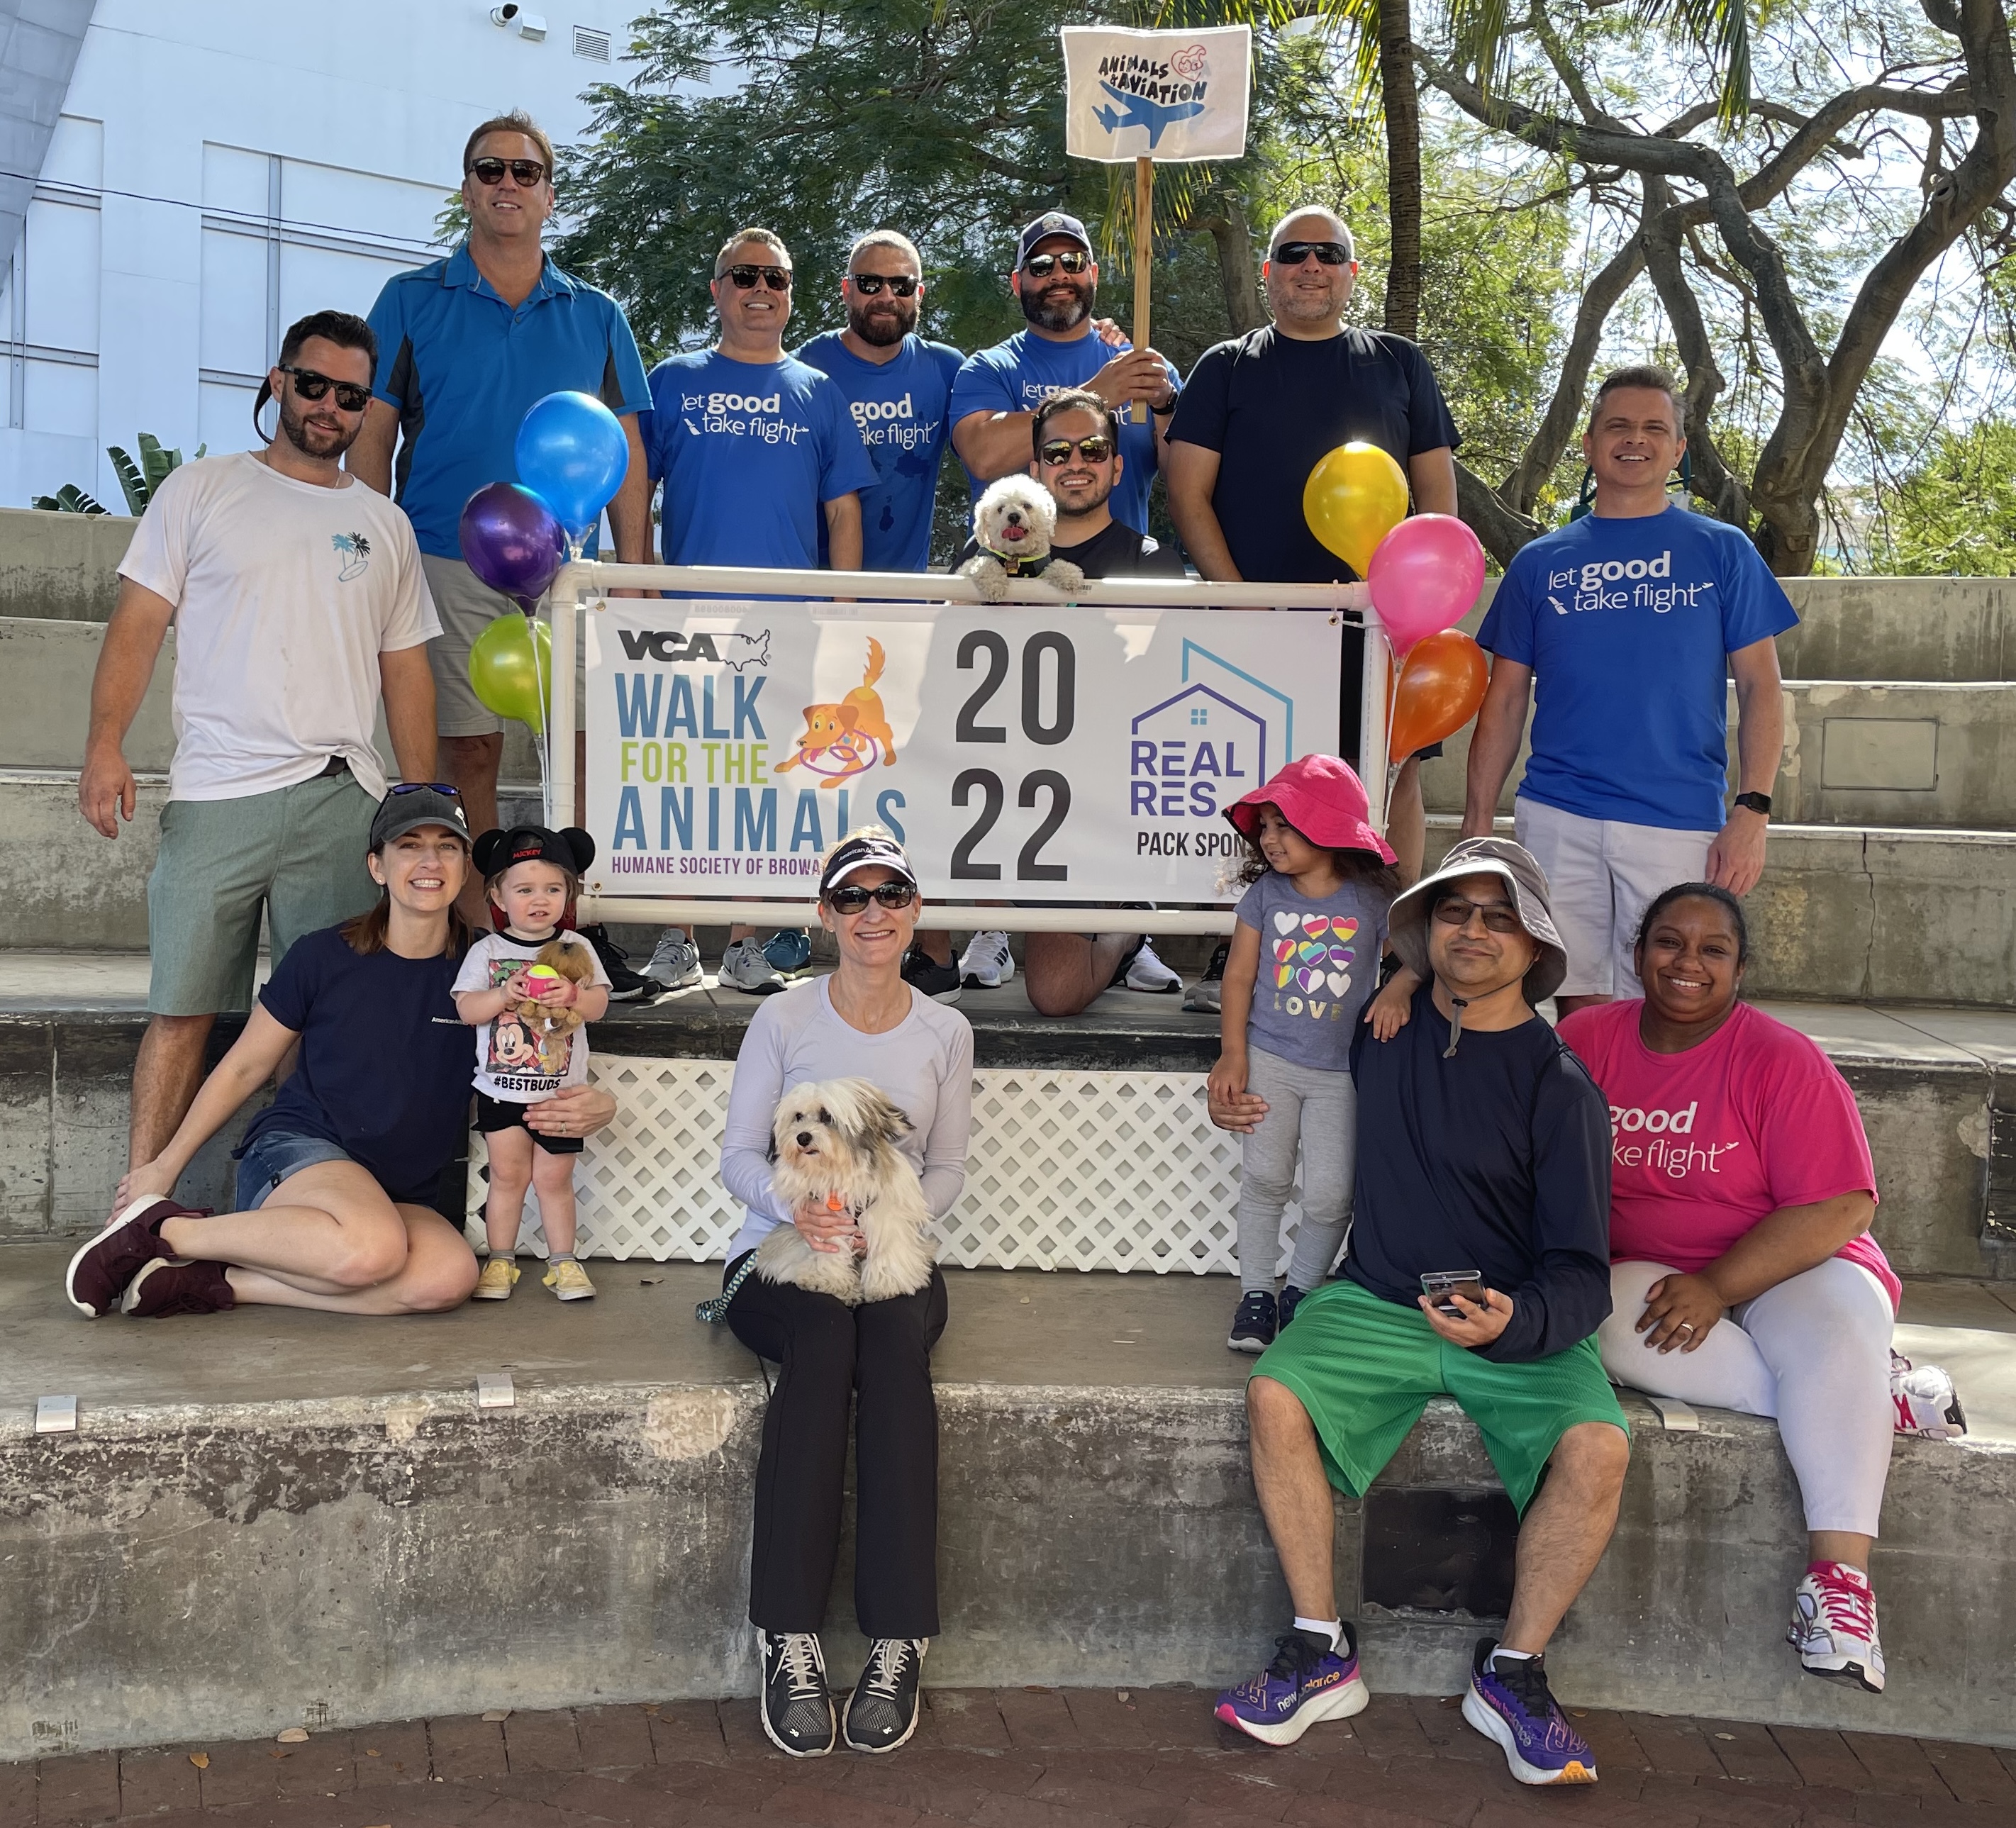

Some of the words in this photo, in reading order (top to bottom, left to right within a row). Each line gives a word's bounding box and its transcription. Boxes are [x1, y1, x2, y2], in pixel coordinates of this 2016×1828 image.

[1098, 55, 1169, 79] ANIMALS
[1118, 72, 1207, 104] AVIATION
[681, 393, 706, 412] let
[707, 393, 781, 414] good
[1022, 380, 1045, 399] let
[850, 393, 913, 428] good
[701, 412, 745, 435] take
[749, 418, 803, 445] flight
[859, 425, 885, 445] ake
[887, 423, 933, 450] flight
[1548, 567, 1578, 591] let
[1580, 551, 1671, 592] good
[1574, 587, 1629, 612] take
[1632, 582, 1702, 613] flight
[617, 630, 720, 662] VCA
[956, 630, 1076, 745] 20
[615, 673, 767, 740] WALK
[621, 742, 687, 782] FOR
[701, 743, 769, 784] THE
[1131, 740, 1245, 777] REAL
[950, 768, 1071, 881] 22
[513, 848, 542, 859] MICKEY
[1137, 832, 1189, 856] PACK
[1195, 832, 1247, 857] SPON
[612, 857, 674, 874] HUMANE
[680, 857, 741, 874] SOCIETY
[747, 858, 764, 875] OF
[769, 859, 823, 876] BROWA
[1274, 993, 1344, 1021] LOVE
[494, 1075, 561, 1091] #BESTBUDS
[1647, 1139, 1725, 1178] flight
[1277, 1691, 1297, 1712] new
